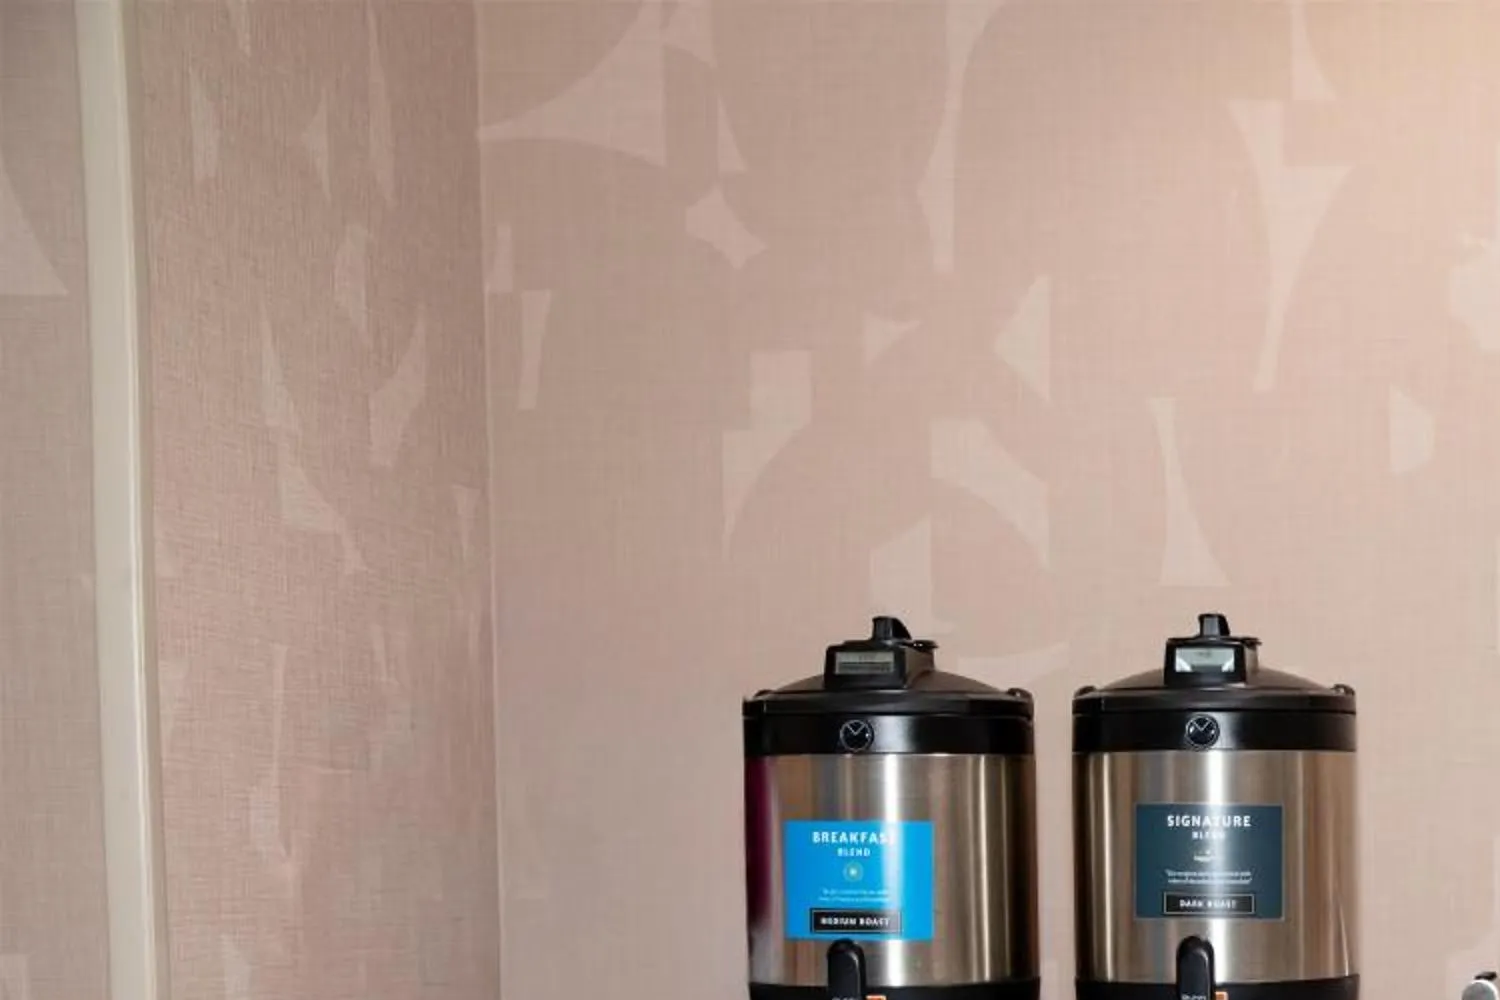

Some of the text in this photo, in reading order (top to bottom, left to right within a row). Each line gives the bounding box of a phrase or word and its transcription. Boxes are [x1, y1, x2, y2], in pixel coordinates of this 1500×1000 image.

[1166, 815, 1252, 828] SIGNATURE
[837, 847, 871, 857] BLEND
[1179, 899, 1204, 909] DARK
[820, 917, 890, 927] MEDIUM ROAST
